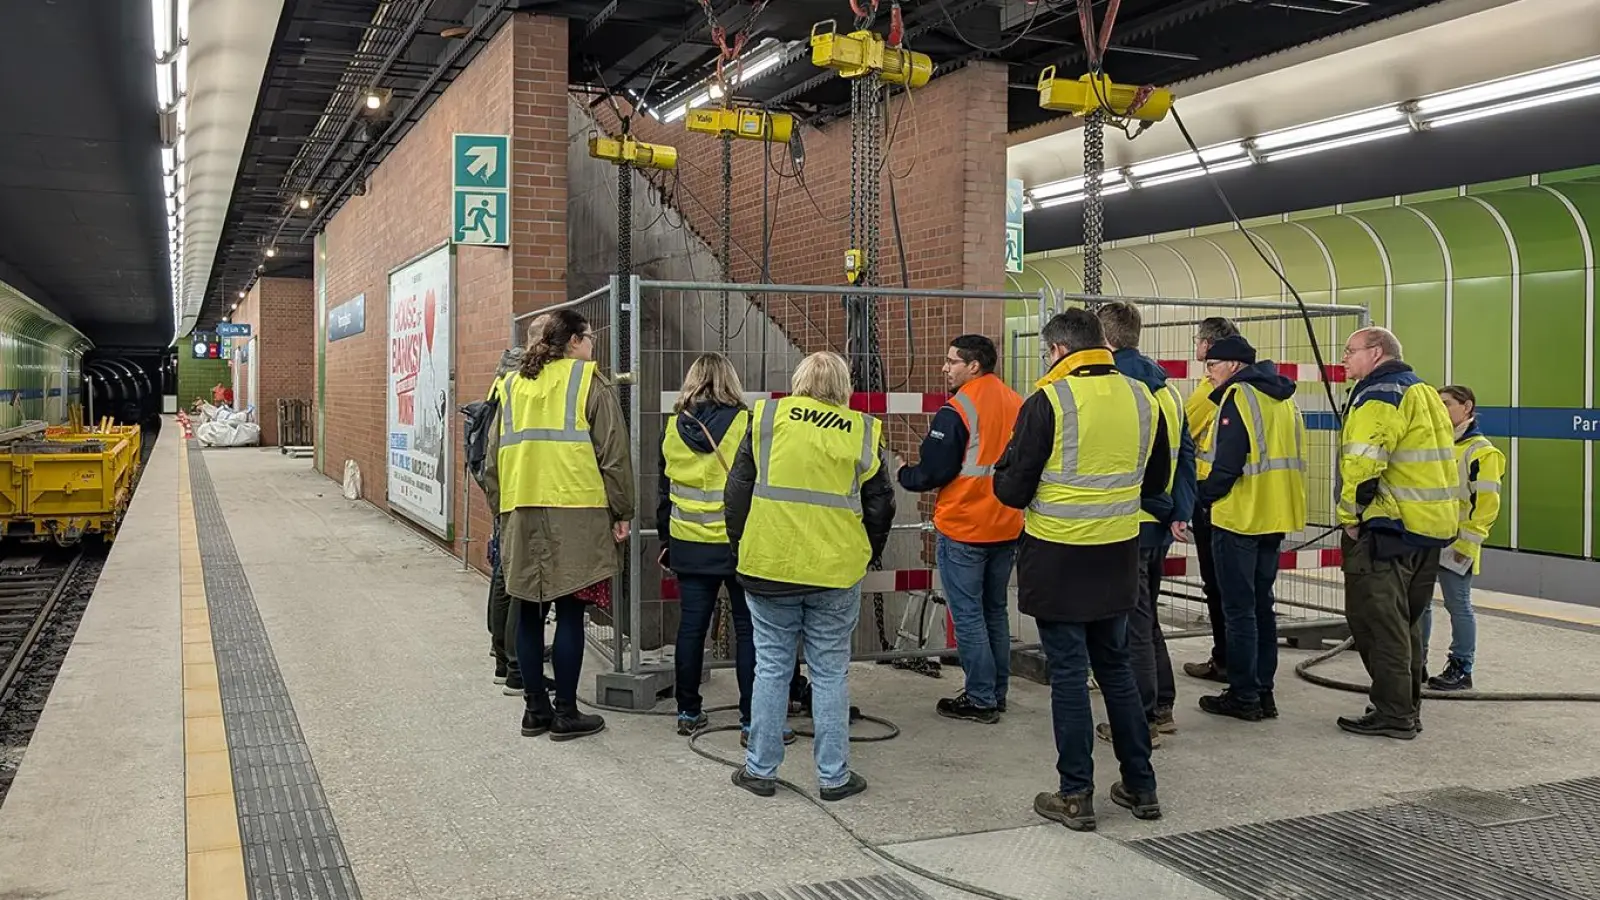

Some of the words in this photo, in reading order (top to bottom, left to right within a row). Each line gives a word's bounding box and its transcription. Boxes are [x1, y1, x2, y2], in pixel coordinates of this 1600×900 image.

[697, 114, 713, 123] Yale
[392, 332, 423, 374] BANKSY
[1573, 415, 1600, 431] Par
